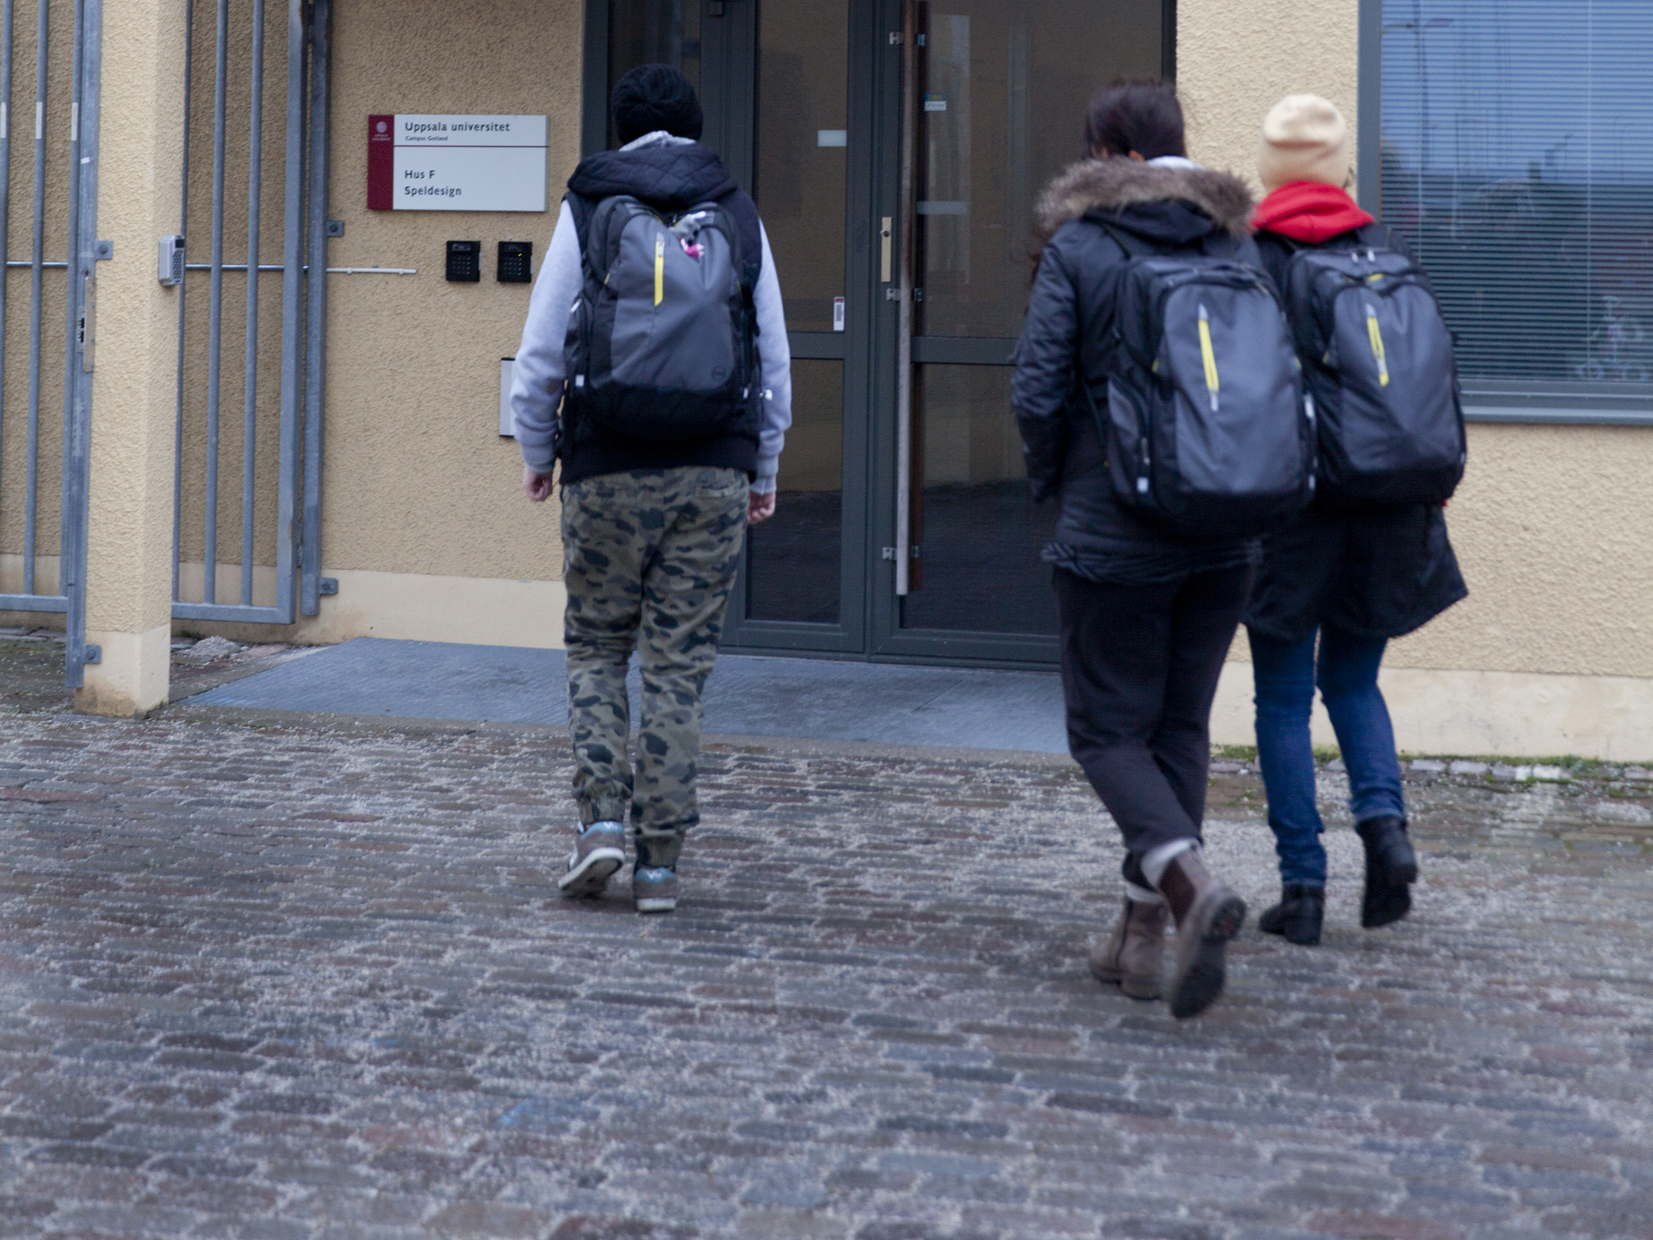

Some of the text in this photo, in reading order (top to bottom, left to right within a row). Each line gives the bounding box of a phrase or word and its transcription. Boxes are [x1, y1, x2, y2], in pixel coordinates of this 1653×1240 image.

[404, 121, 511, 134] Uppsala universitet
[404, 169, 436, 179] Hus F
[404, 185, 462, 198] Speldesign
